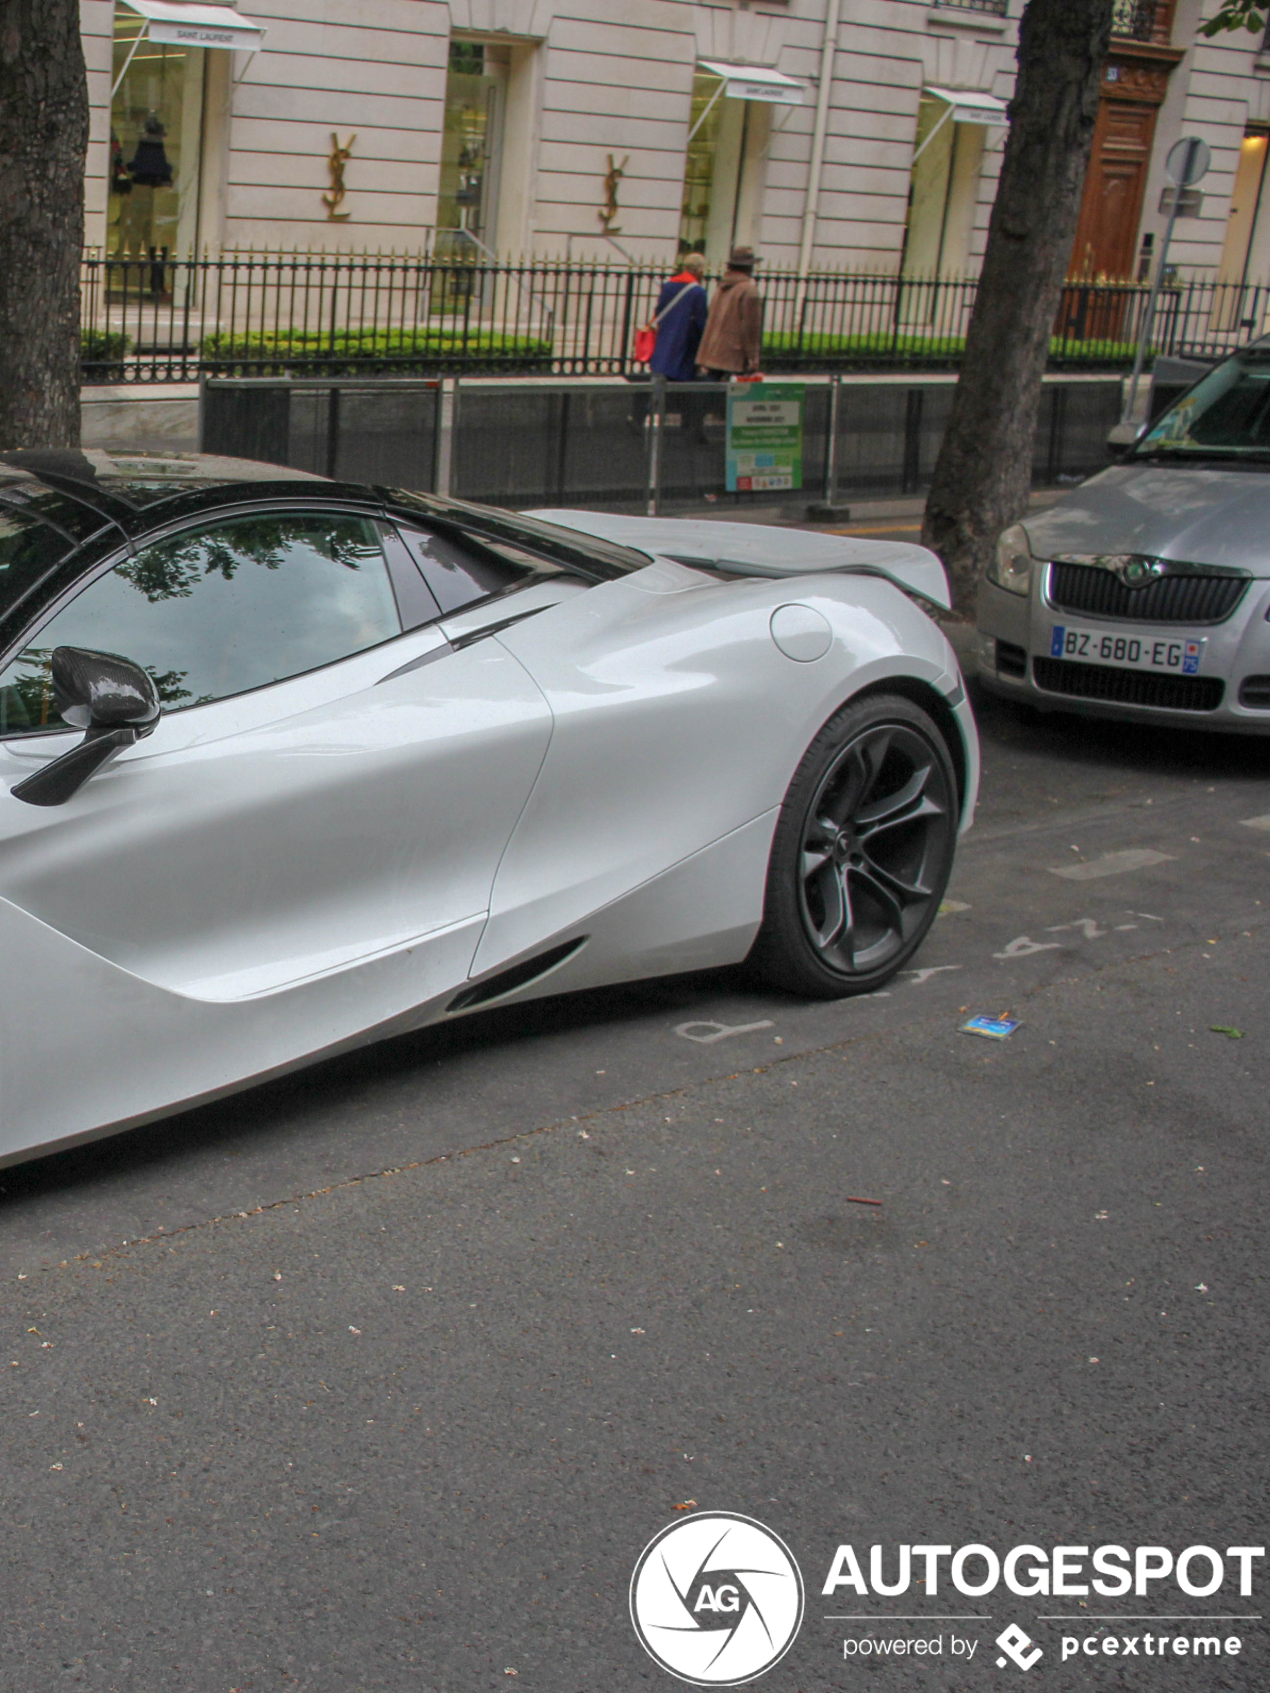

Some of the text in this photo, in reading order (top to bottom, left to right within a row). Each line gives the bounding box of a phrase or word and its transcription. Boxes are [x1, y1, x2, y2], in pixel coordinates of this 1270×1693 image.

[176, 30, 234, 42] SAINT LAURENT
[1065, 632, 1181, 666] BZ-680-EG
